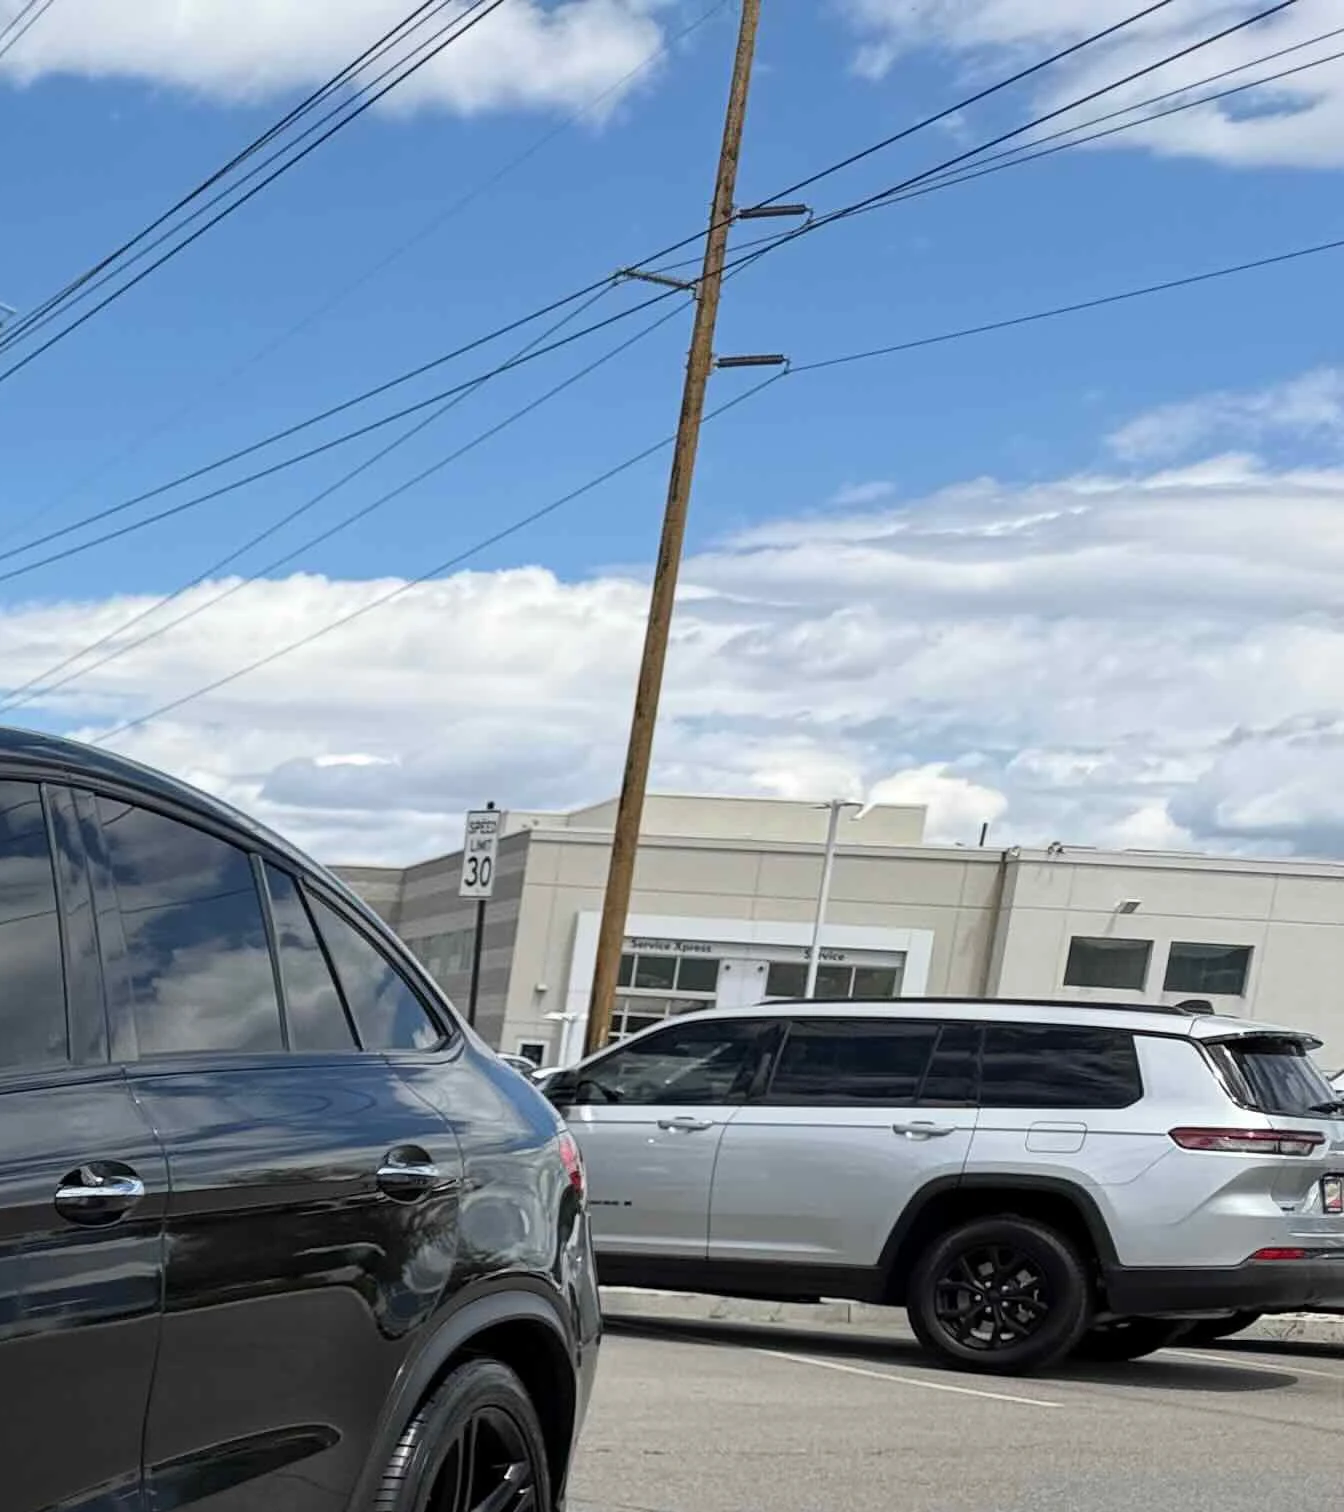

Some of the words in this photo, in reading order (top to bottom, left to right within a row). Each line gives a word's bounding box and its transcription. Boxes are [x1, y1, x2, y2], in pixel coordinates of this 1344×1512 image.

[467, 820, 497, 834] SPEED
[470, 838, 493, 852] LIMIT
[463, 855, 492, 887] 30
[631, 938, 670, 951] Service
[673, 941, 712, 953] Xpress
[803, 948, 845, 961] Svice
